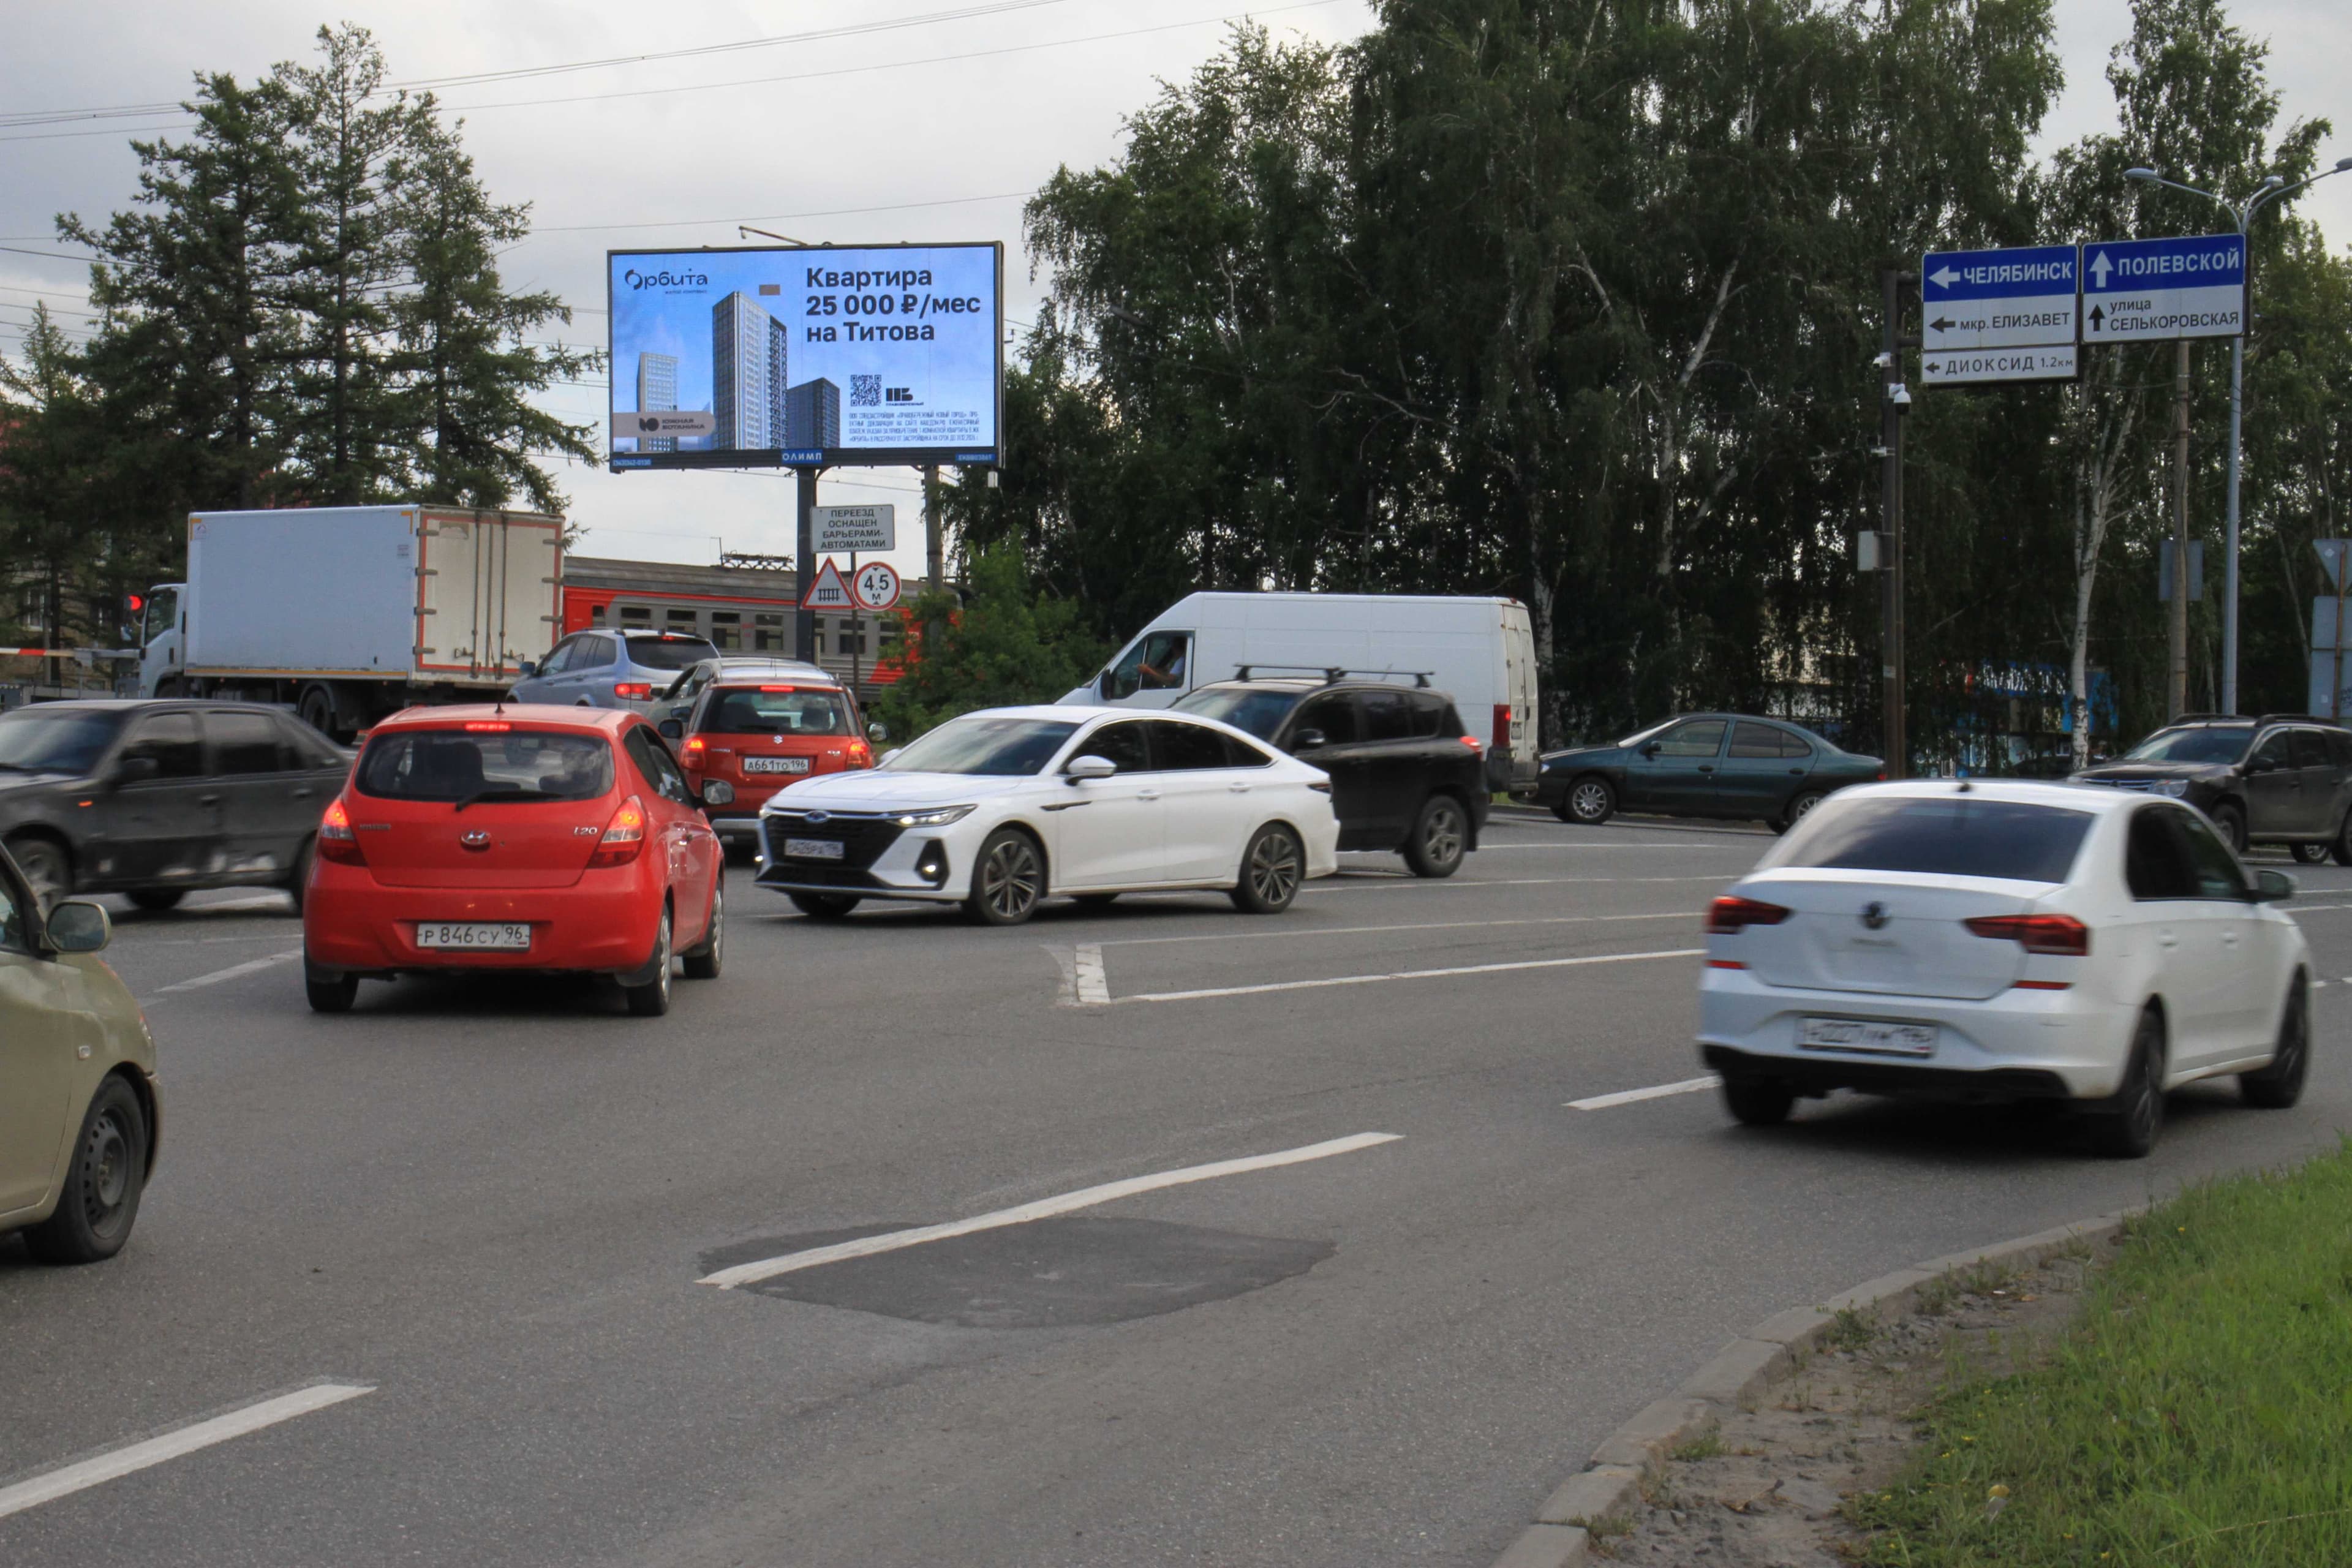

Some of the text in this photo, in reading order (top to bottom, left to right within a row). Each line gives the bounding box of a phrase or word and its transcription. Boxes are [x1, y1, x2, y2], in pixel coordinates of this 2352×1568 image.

[2118, 247, 2240, 276] ПОЛЕВСКОЙ
[806, 267, 932, 292] Квартира
[1964, 262, 2073, 285] ЧЕЛЯБИНСК
[805, 295, 838, 316] 25
[844, 294, 894, 315] 000
[2110, 299, 2152, 314] улица
[1960, 312, 2071, 332] мкр. ЕЛИЗАВЕТ
[2110, 312, 2239, 331] СЕЛЬКОРОВСКАЯ
[807, 321, 935, 342] на Титова
[1945, 356, 2035, 375] ДИОКСИД
[782, 452, 823, 461] ОЛИМП
[831, 508, 875, 517] ПЕРЕЕЗД
[828, 519, 878, 528] ОСНАЩЕН
[823, 529, 884, 539] БАРЬЕРАМИ-
[821, 540, 886, 549] АВТОМАТАМИ
[864, 574, 889, 592] 4.5
[504, 926, 524, 940] 96
